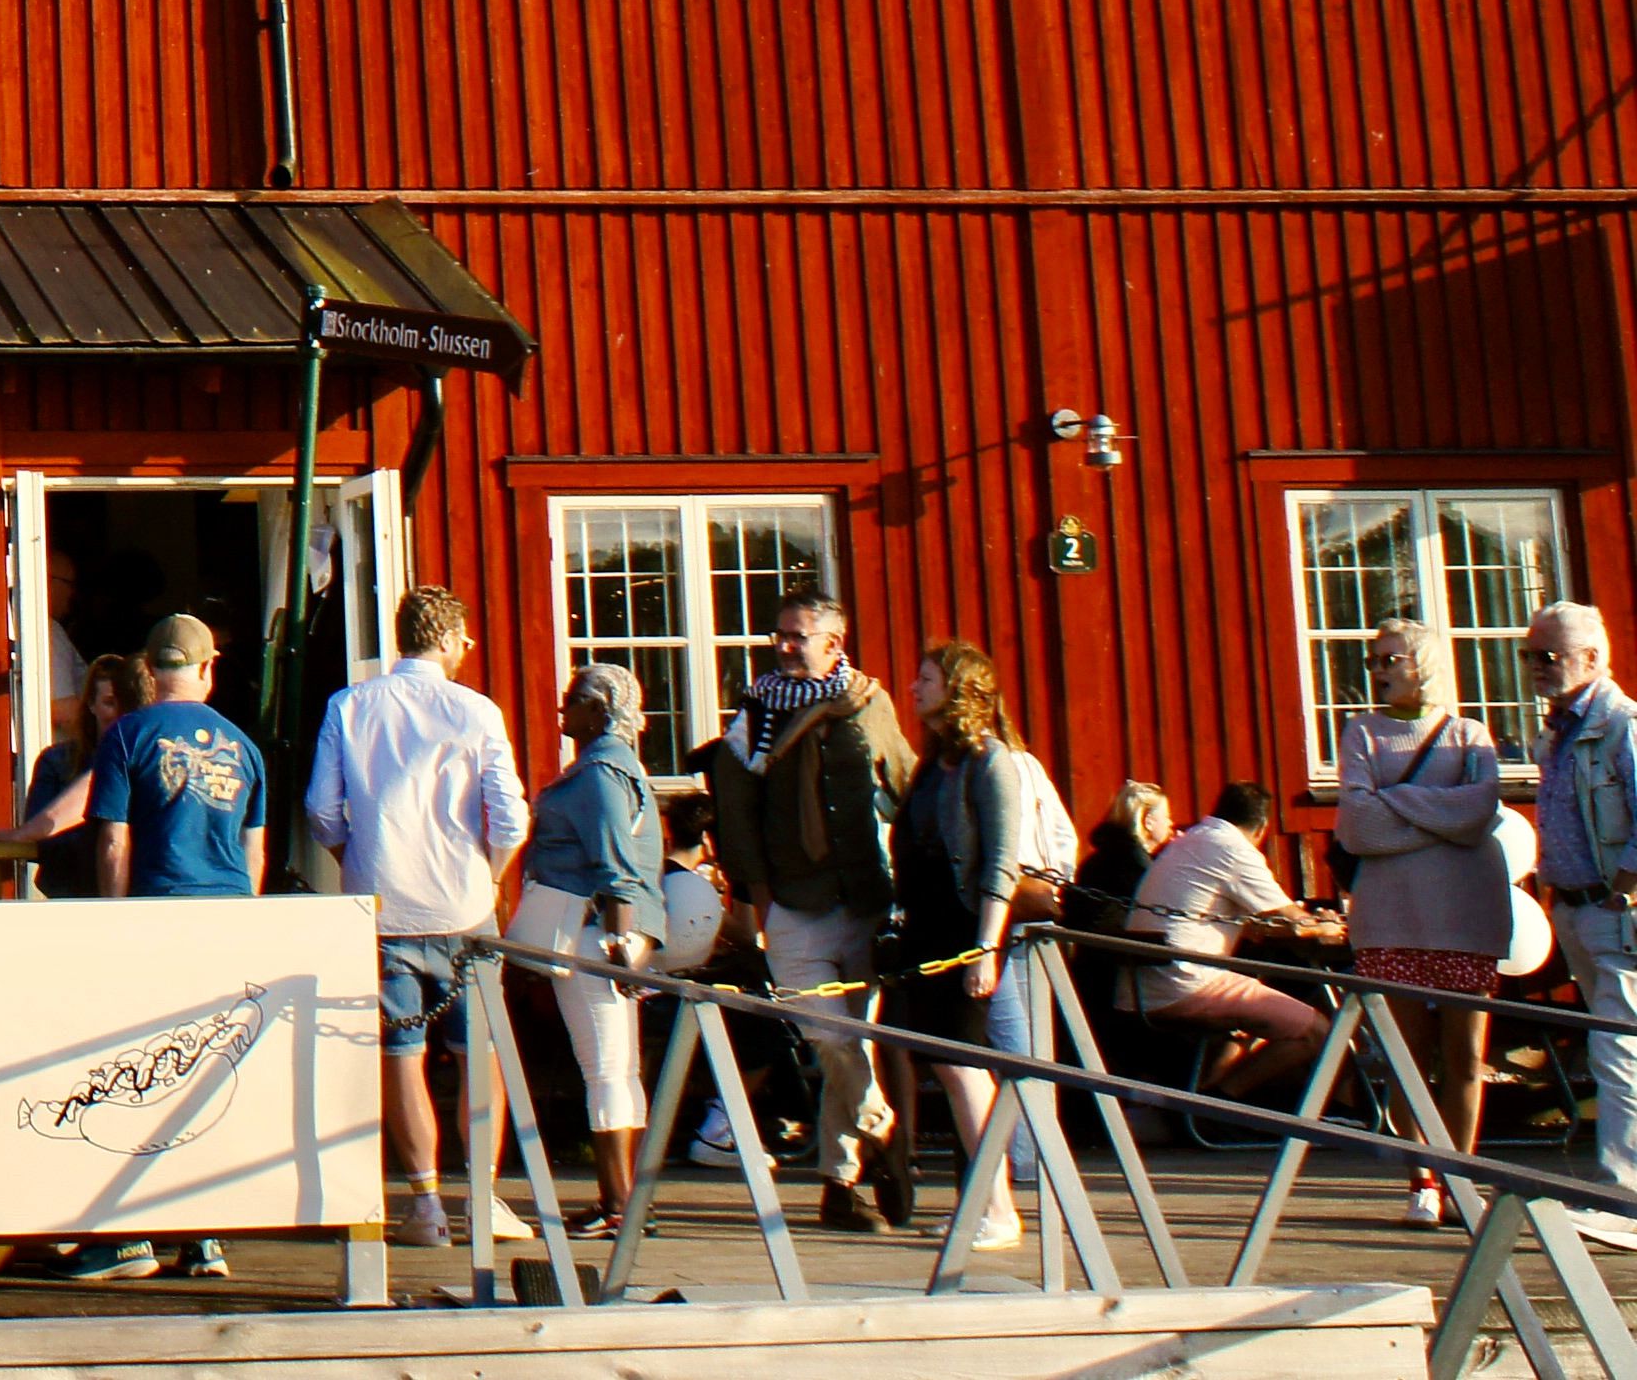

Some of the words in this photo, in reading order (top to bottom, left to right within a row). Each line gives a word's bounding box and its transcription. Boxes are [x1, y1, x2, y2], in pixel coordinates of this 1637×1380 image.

[336, 312, 419, 349] Stockholm
[428, 324, 491, 360] Slussen
[1065, 537, 1081, 559] 2
